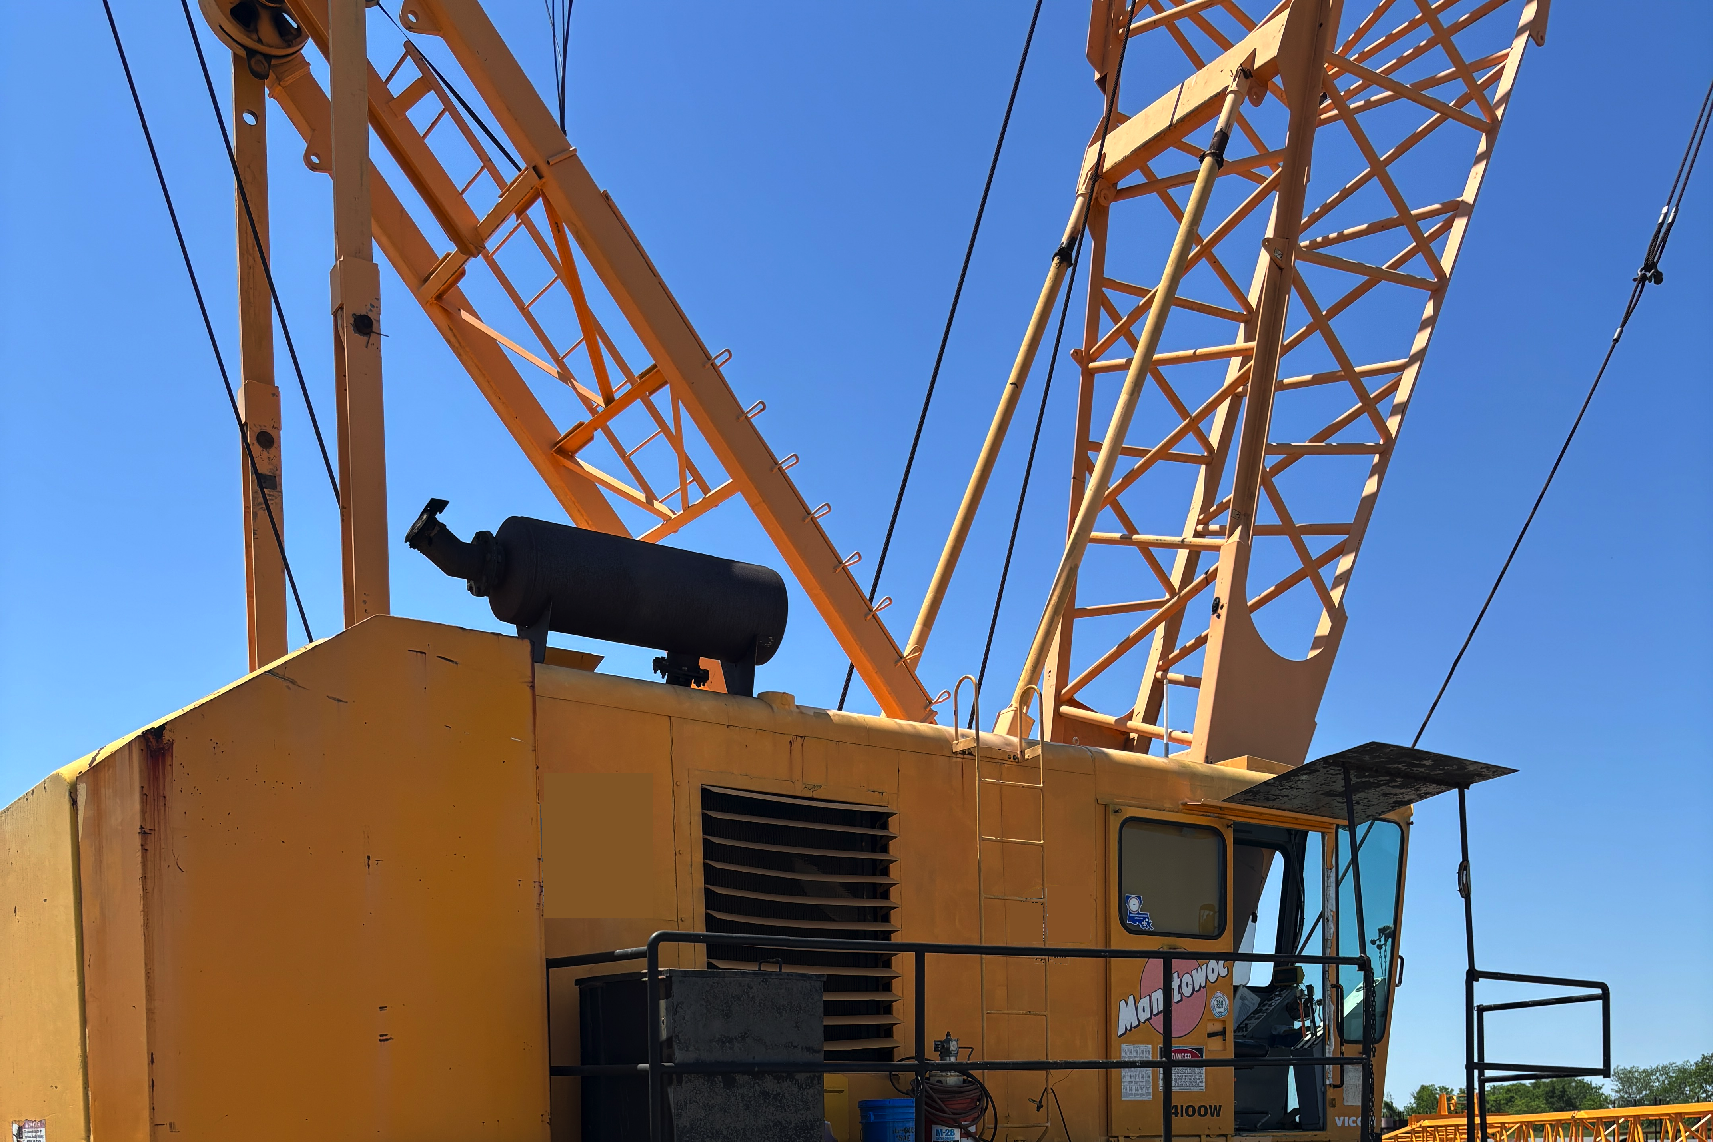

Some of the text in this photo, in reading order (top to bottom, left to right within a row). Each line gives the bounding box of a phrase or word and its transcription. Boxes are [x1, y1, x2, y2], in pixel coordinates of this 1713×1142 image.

[1117, 959, 1229, 1038] Mantowoc
[1172, 1104, 1222, 1117] 4100W
[1335, 1116, 1376, 1127] VIC
[936, 1128, 955, 1137] M-28
